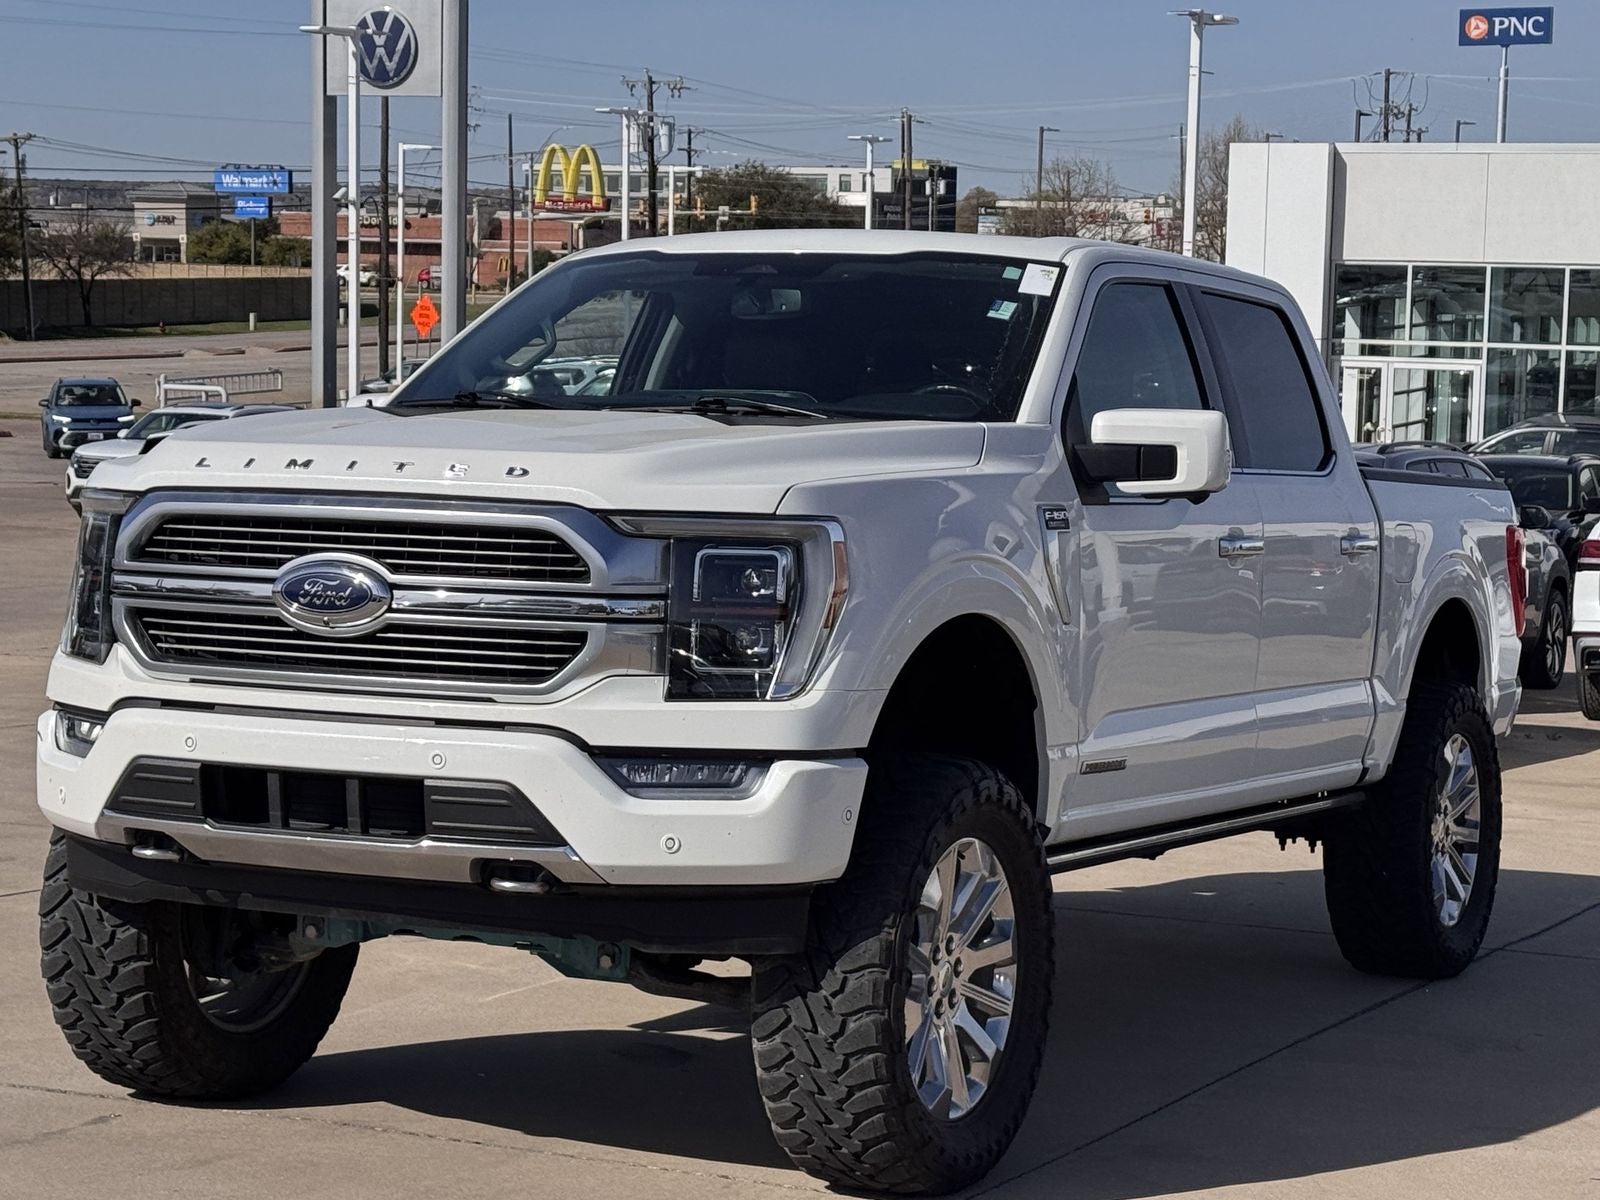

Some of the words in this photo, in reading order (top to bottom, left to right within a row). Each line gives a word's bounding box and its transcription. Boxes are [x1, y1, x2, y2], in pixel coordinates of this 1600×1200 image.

[1492, 16, 1545, 37] PNC
[221, 174, 268, 188] Walmart
[195, 456, 531, 478] LIMITED
[1044, 511, 1069, 520] F-150
[298, 578, 353, 606] Ford
